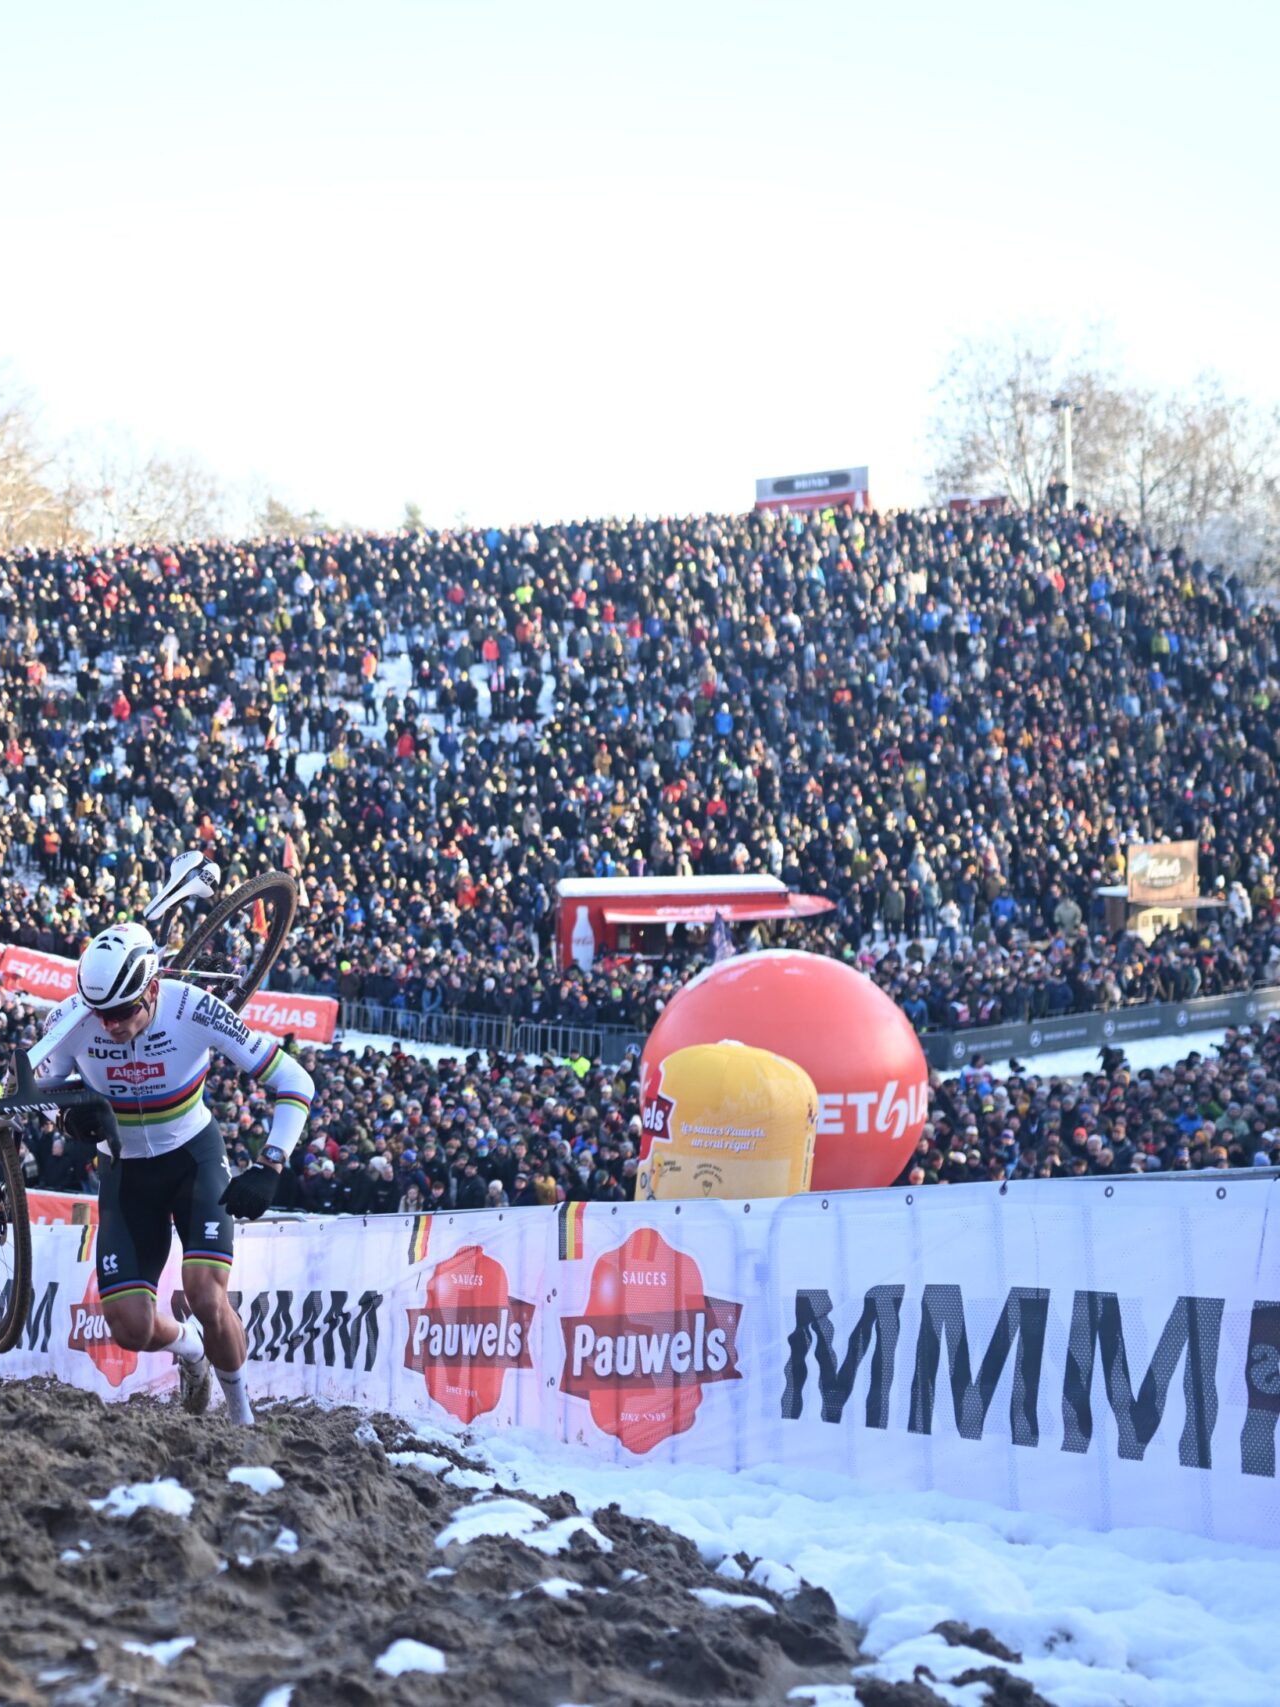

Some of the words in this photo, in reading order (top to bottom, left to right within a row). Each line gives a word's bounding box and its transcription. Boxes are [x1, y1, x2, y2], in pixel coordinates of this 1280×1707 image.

[195, 994, 250, 1039] Alpecin
[213, 1021, 247, 1046] SHAMPOO
[95, 1048, 128, 1060] UCI
[112, 1065, 159, 1080] Alpecin
[452, 1273, 484, 1287] SAUCES
[622, 1270, 667, 1286] SAUCES
[412, 1308, 523, 1358] Pauwels
[573, 1312, 728, 1377] Pauwels
